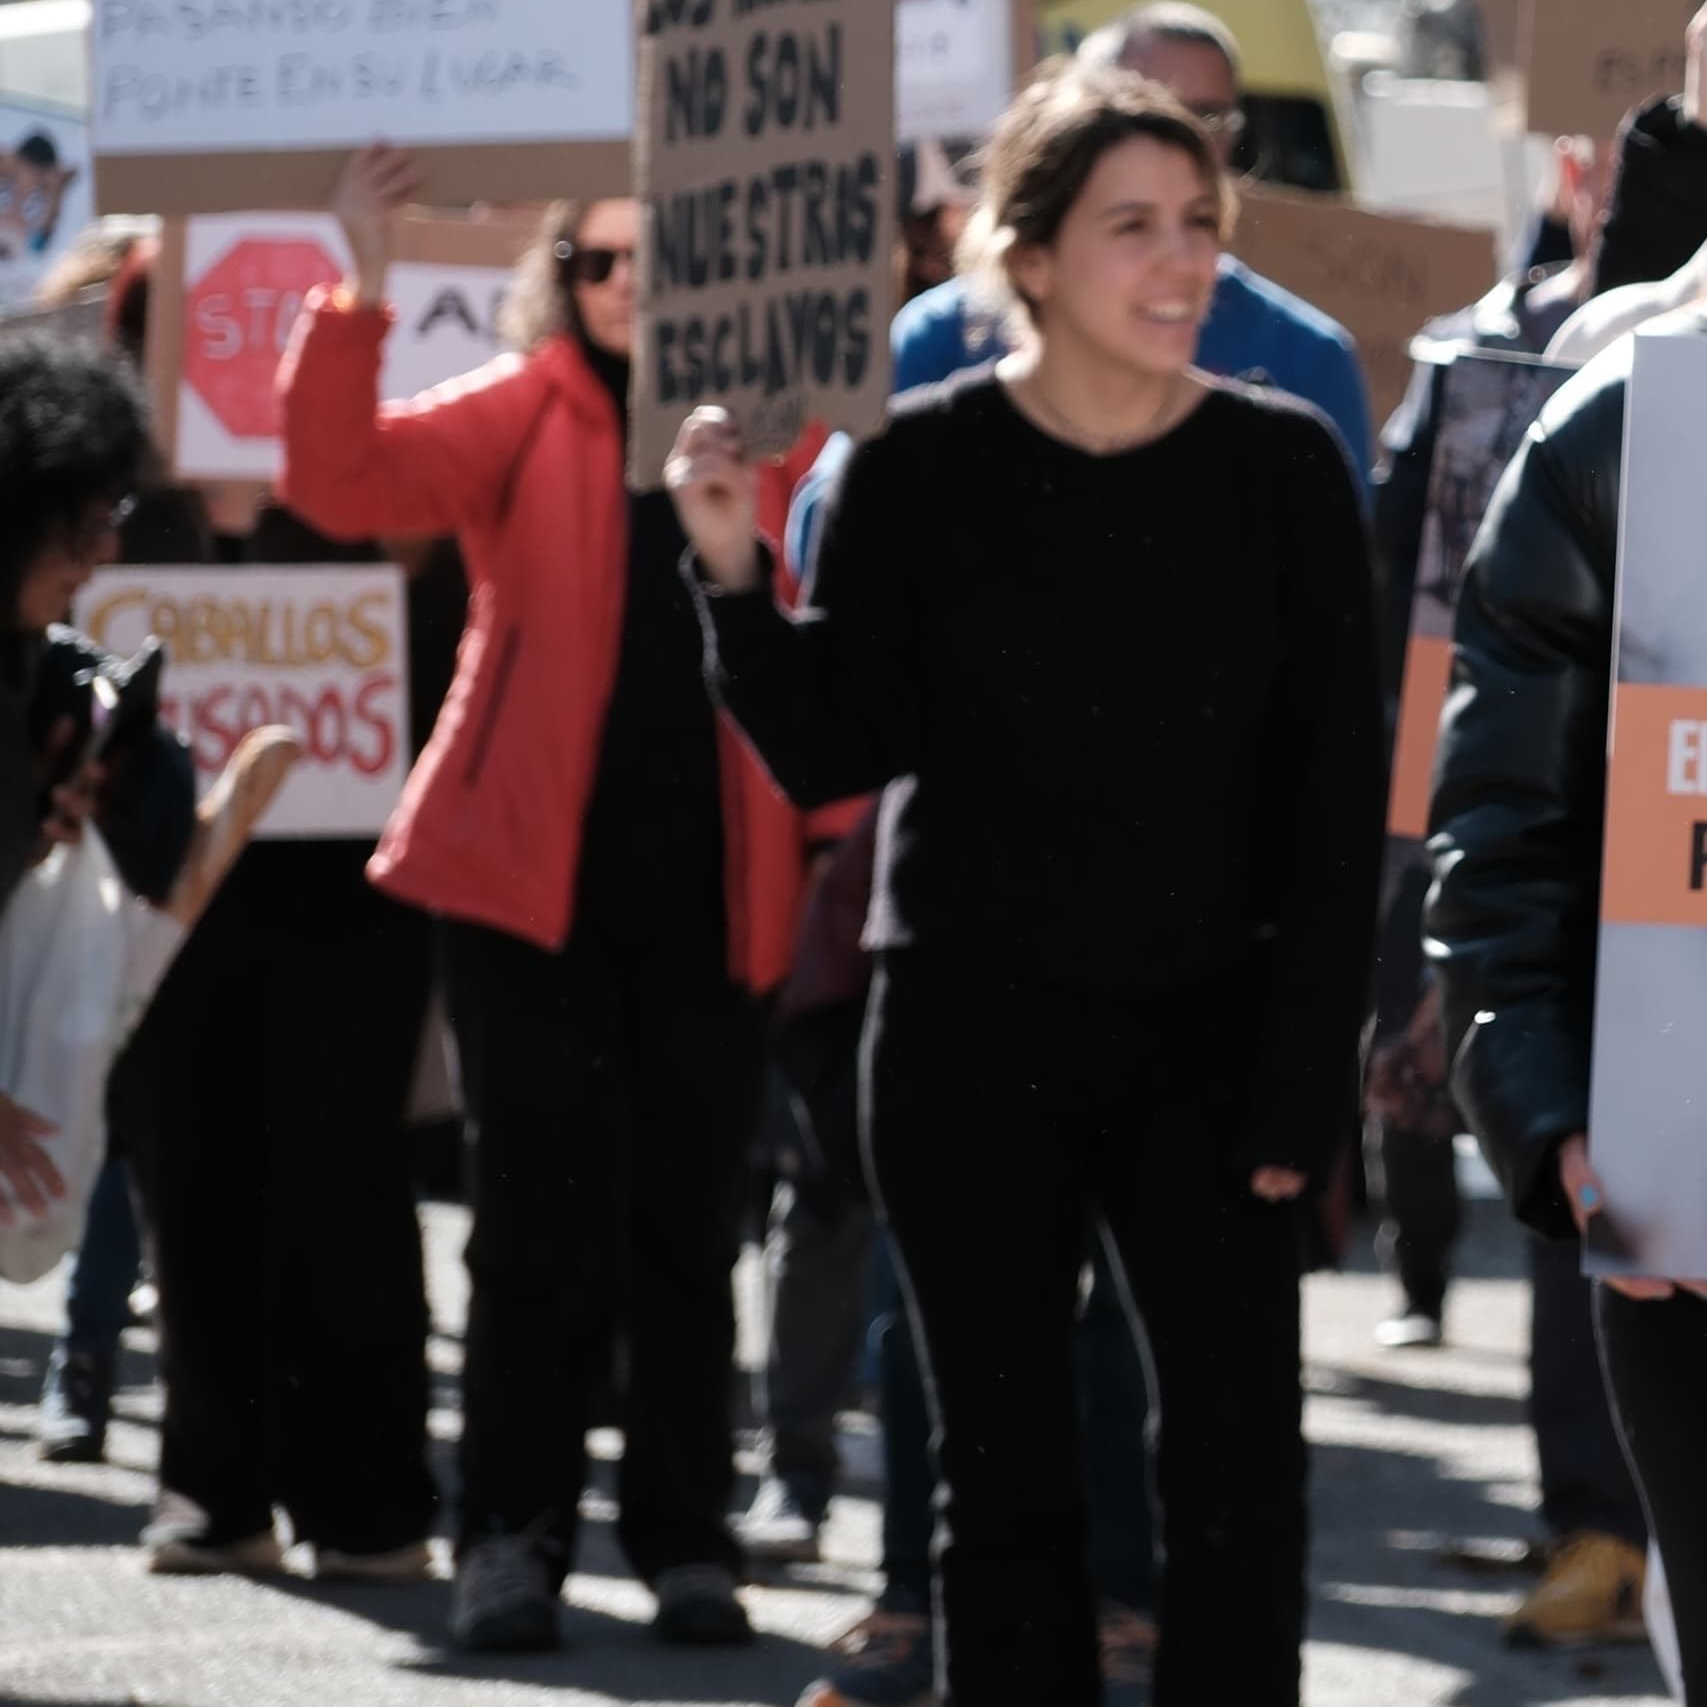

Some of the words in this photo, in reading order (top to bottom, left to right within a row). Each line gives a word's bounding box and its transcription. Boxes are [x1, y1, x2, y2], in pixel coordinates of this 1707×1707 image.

[665, 47, 727, 147] NO
[744, 21, 843, 137] SON
[657, 287, 870, 402] ESCLAVOS
[88, 588, 394, 670] CABALLOS
